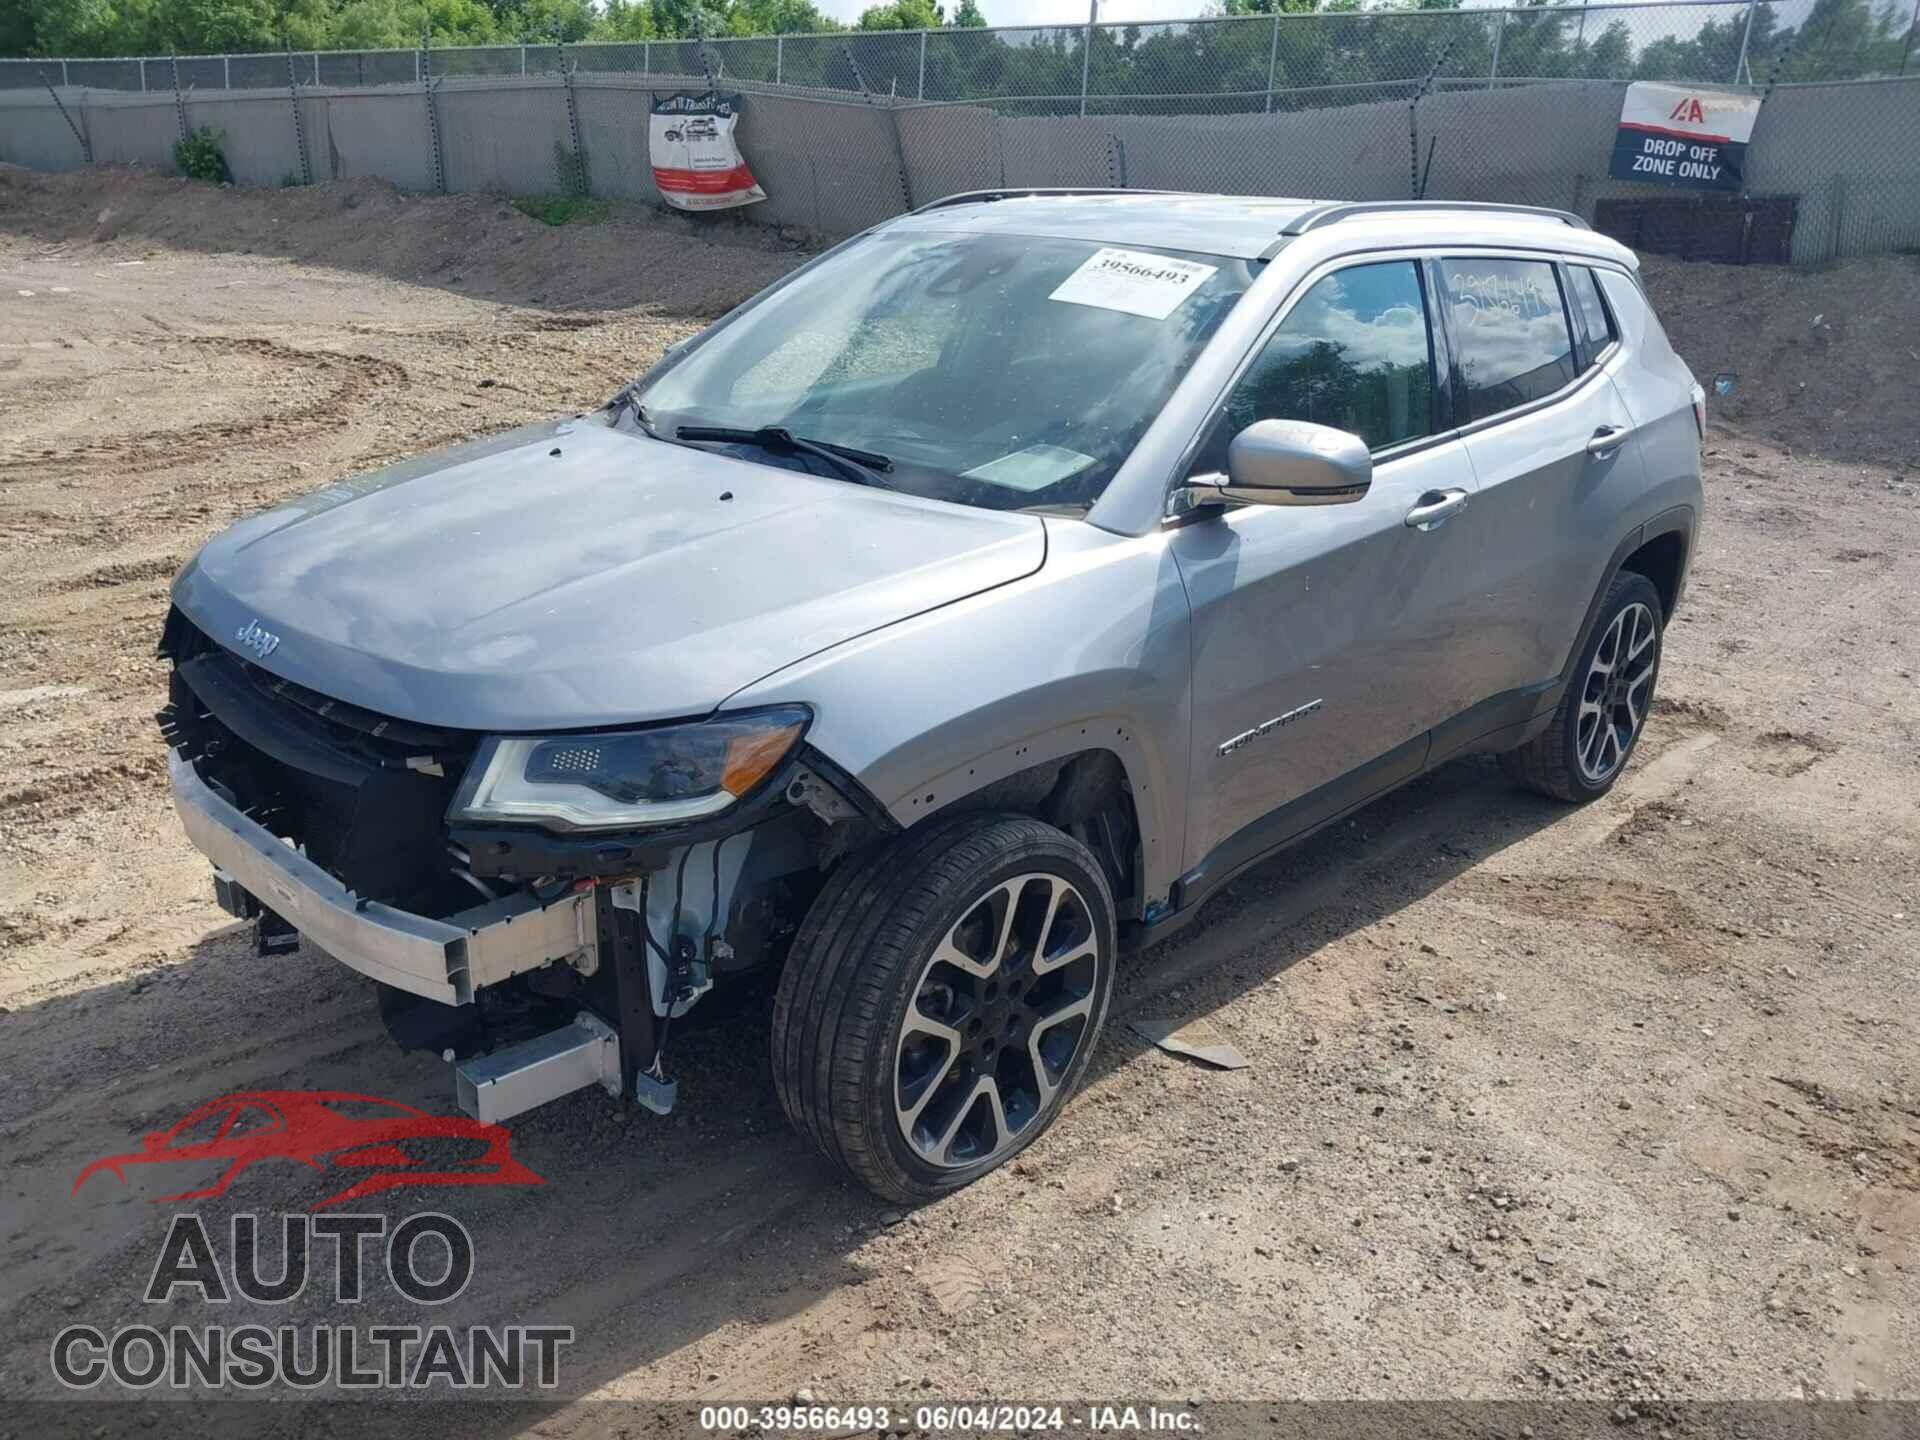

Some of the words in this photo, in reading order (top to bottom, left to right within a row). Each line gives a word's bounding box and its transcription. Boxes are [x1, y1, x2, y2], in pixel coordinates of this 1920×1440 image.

[1643, 137, 1686, 158] DROP
[1689, 145, 1718, 163] OFF
[1632, 155, 1675, 176] ZONE
[1678, 161, 1721, 181] ONLY
[1095, 258, 1190, 285] 39566493
[234, 618, 280, 659] Jeep
